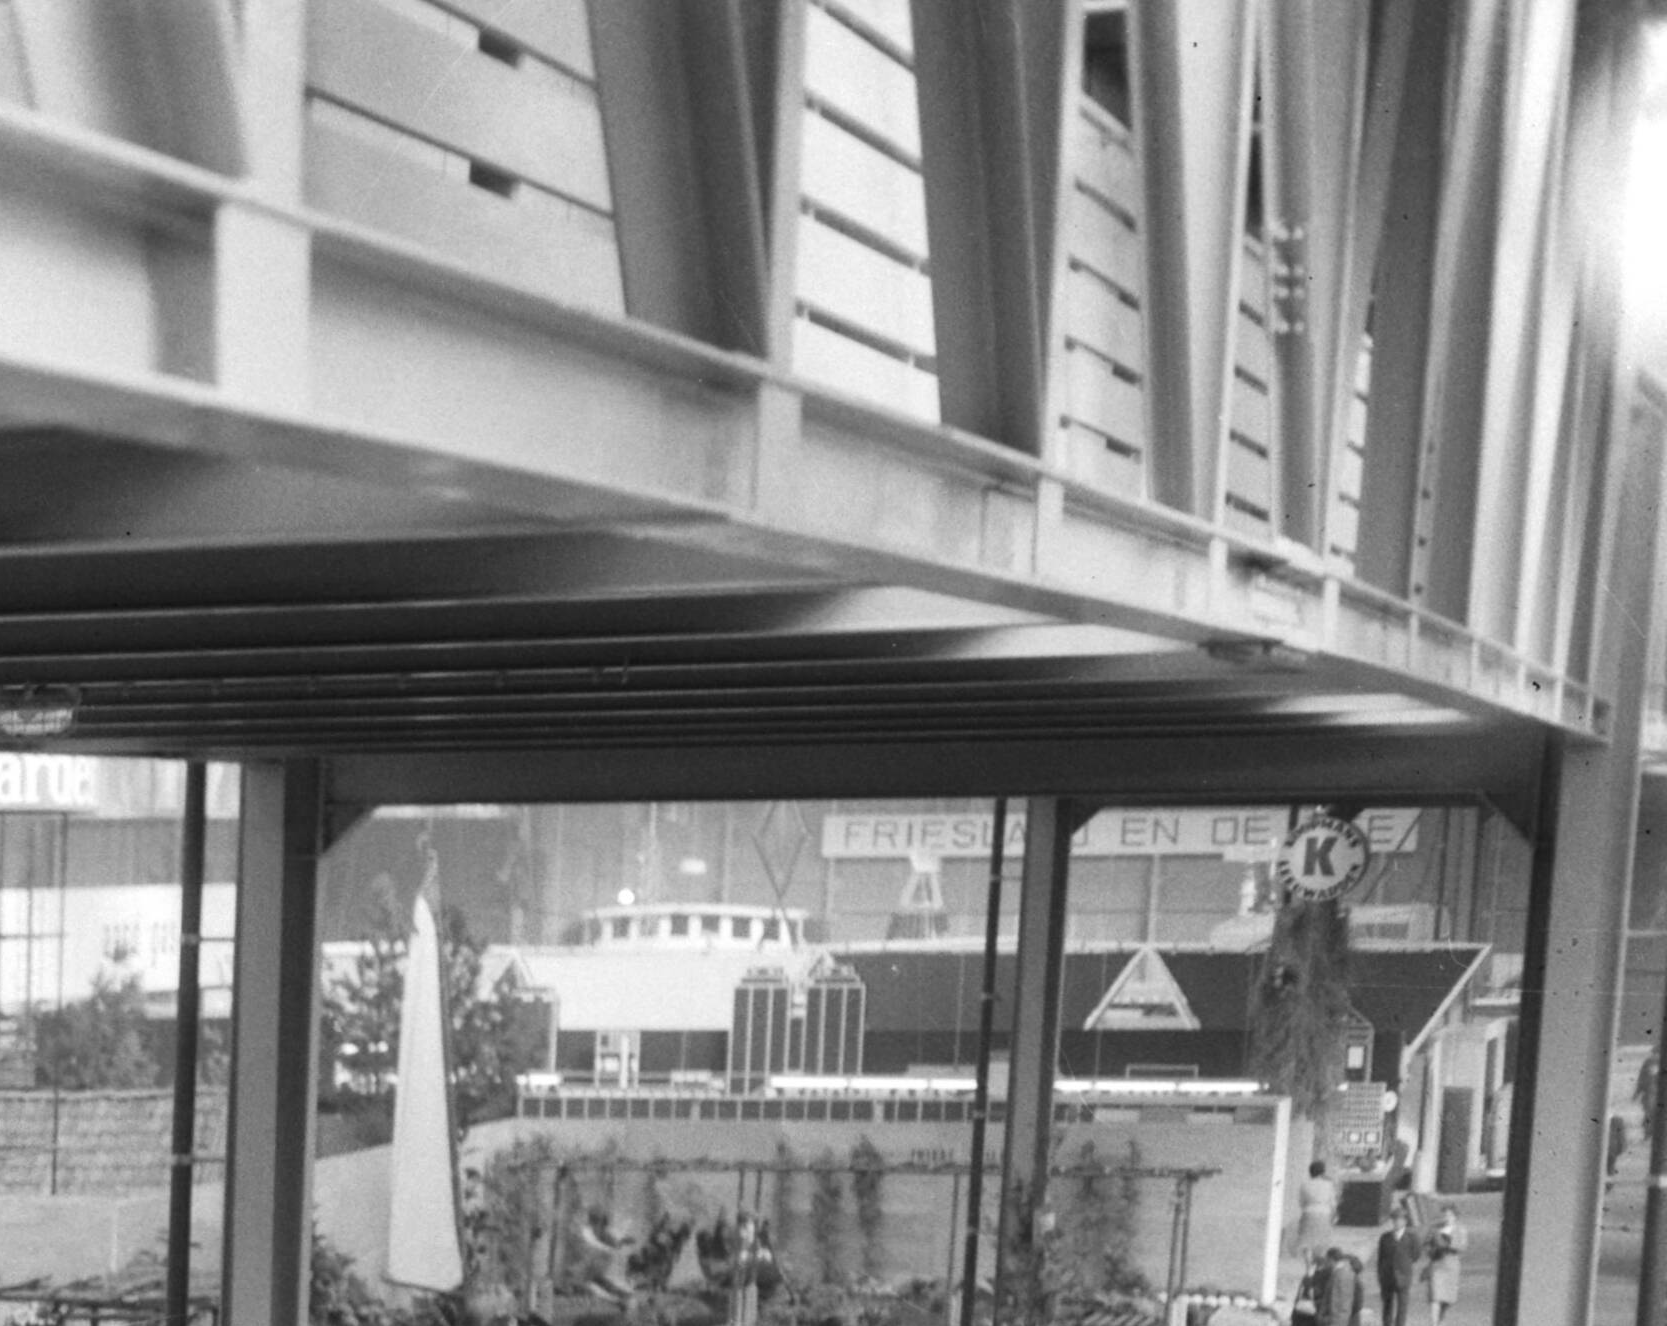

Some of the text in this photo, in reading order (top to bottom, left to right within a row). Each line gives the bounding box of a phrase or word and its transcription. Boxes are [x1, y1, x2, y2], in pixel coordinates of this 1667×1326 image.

[1121, 816, 1179, 846] EN
[1212, 816, 1270, 846] DE
[1302, 836, 1340, 877] K
